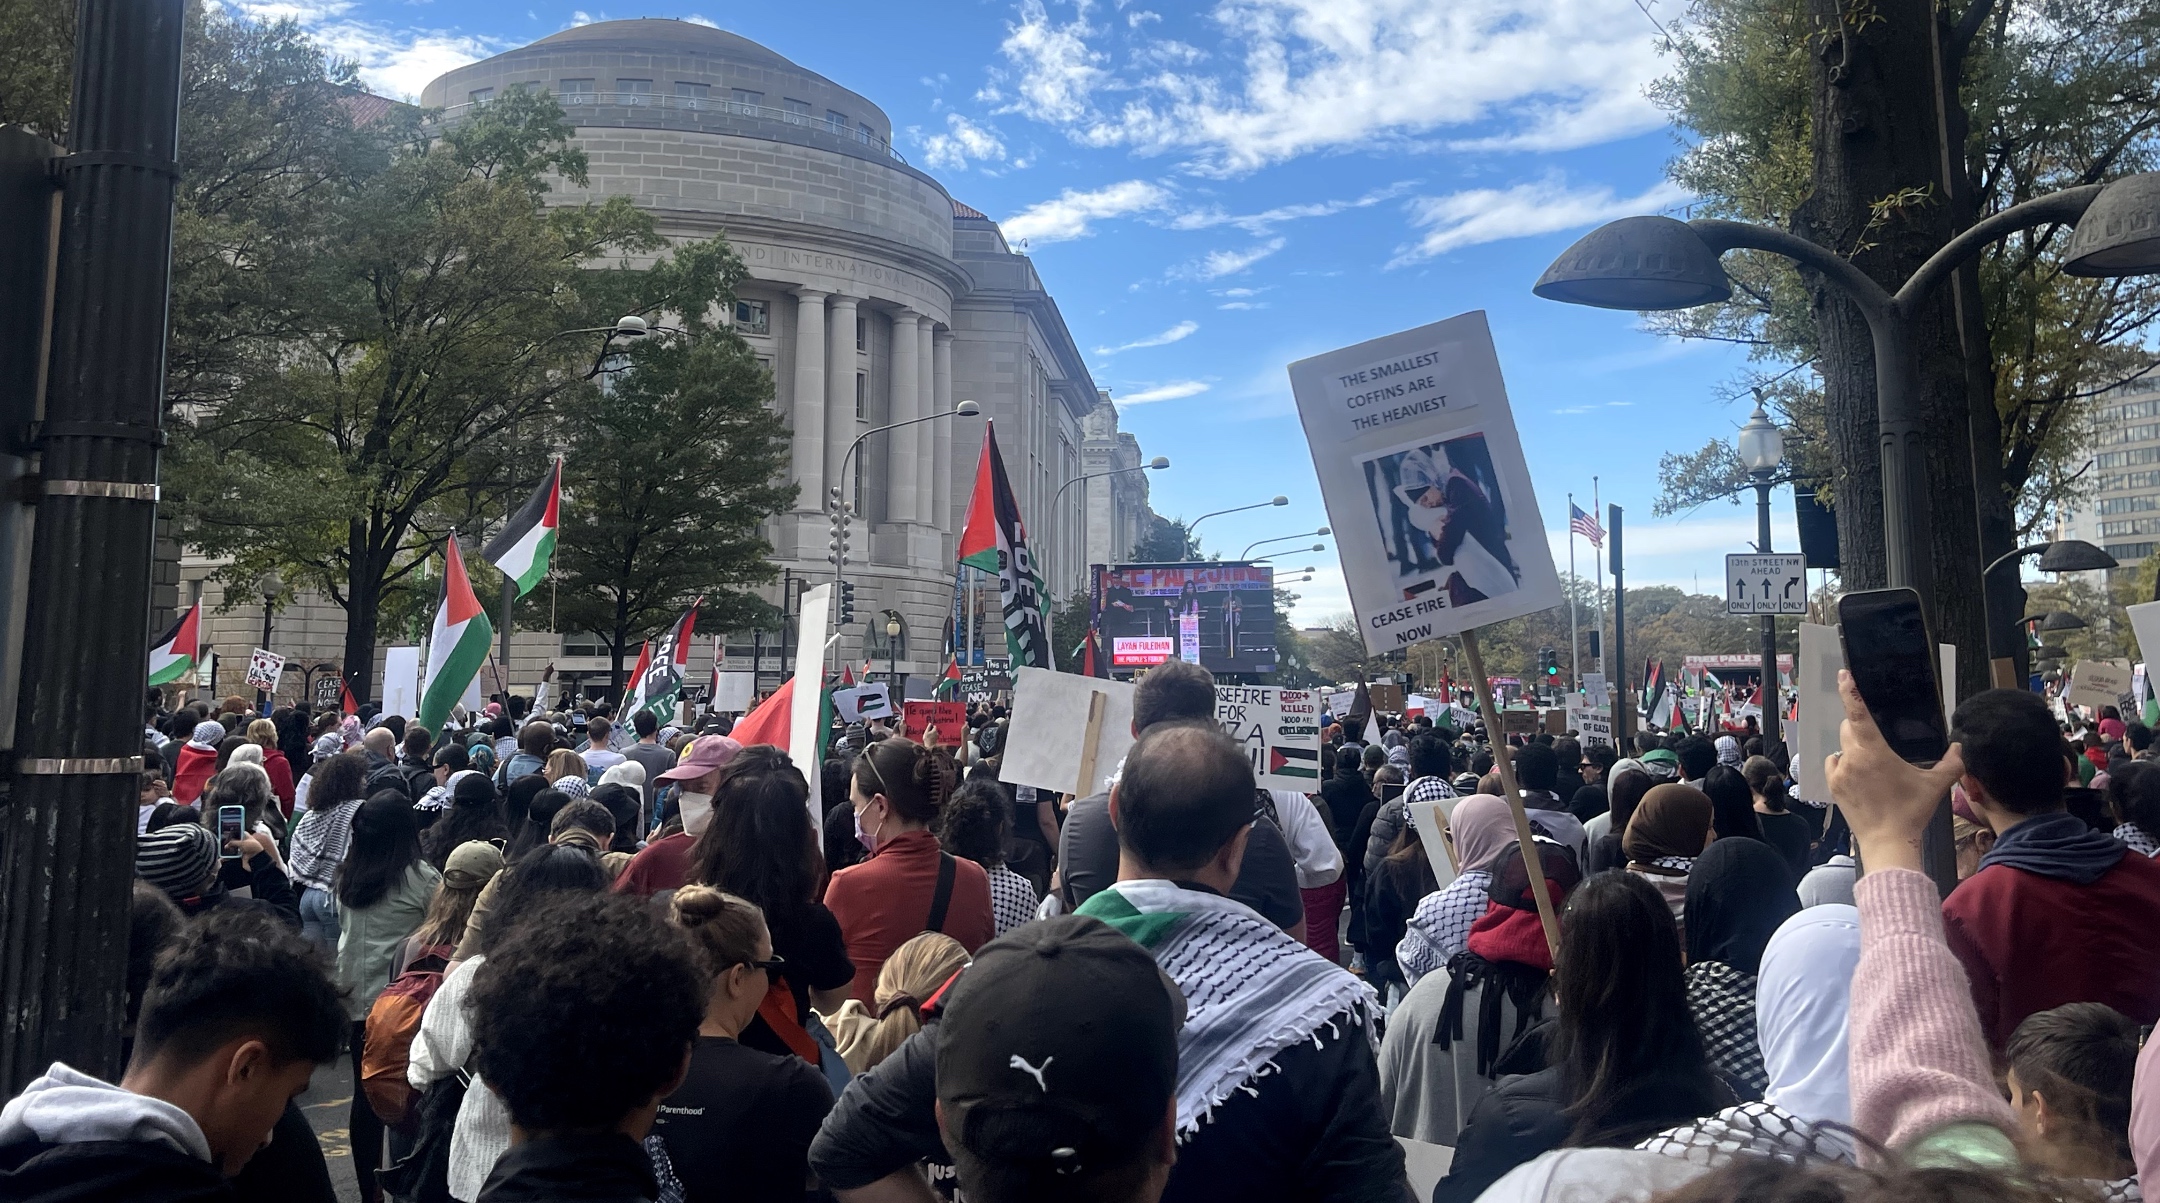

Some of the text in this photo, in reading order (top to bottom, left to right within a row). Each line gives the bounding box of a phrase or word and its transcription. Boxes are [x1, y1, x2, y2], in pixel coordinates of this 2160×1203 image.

[783, 253, 908, 287] INTERNATIONAL
[1339, 351, 1440, 389] THE SMALLEST
[1346, 375, 1436, 409] COFFINS ARE
[1352, 395, 1448, 431] THE HEAVIEST
[1731, 558, 1799, 566] 13th STREET NW
[1751, 567, 1781, 575] AHEAD
[1731, 602, 1751, 610] ONLY
[1757, 602, 1777, 610] ONLY
[1783, 602, 1804, 610] ONLY
[1371, 596, 1446, 629] CEASE FIRE
[1396, 623, 1432, 644] NOW
[1117, 641, 1169, 650] LAYAN FULEIHAN
[1720, 654, 1792, 663] PALESNE
[986, 660, 1000, 669] This
[962, 674, 974, 682] Free
[317, 680, 341, 689] CEASE
[961, 683, 981, 692] CEASE
[319, 689, 336, 698] FIRE
[967, 691, 992, 702] NOW
[1281, 704, 1314, 713] KILLED
[1218, 705, 1247, 722] FOR
[1281, 716, 1301, 724] 4000
[1584, 723, 1609, 733] OF GAZA
[1219, 721, 1265, 747] AZA
[1588, 736, 1607, 746] FREE
[660, 1105, 703, 1116] Parenthood
[927, 1163, 956, 1185] Jus
